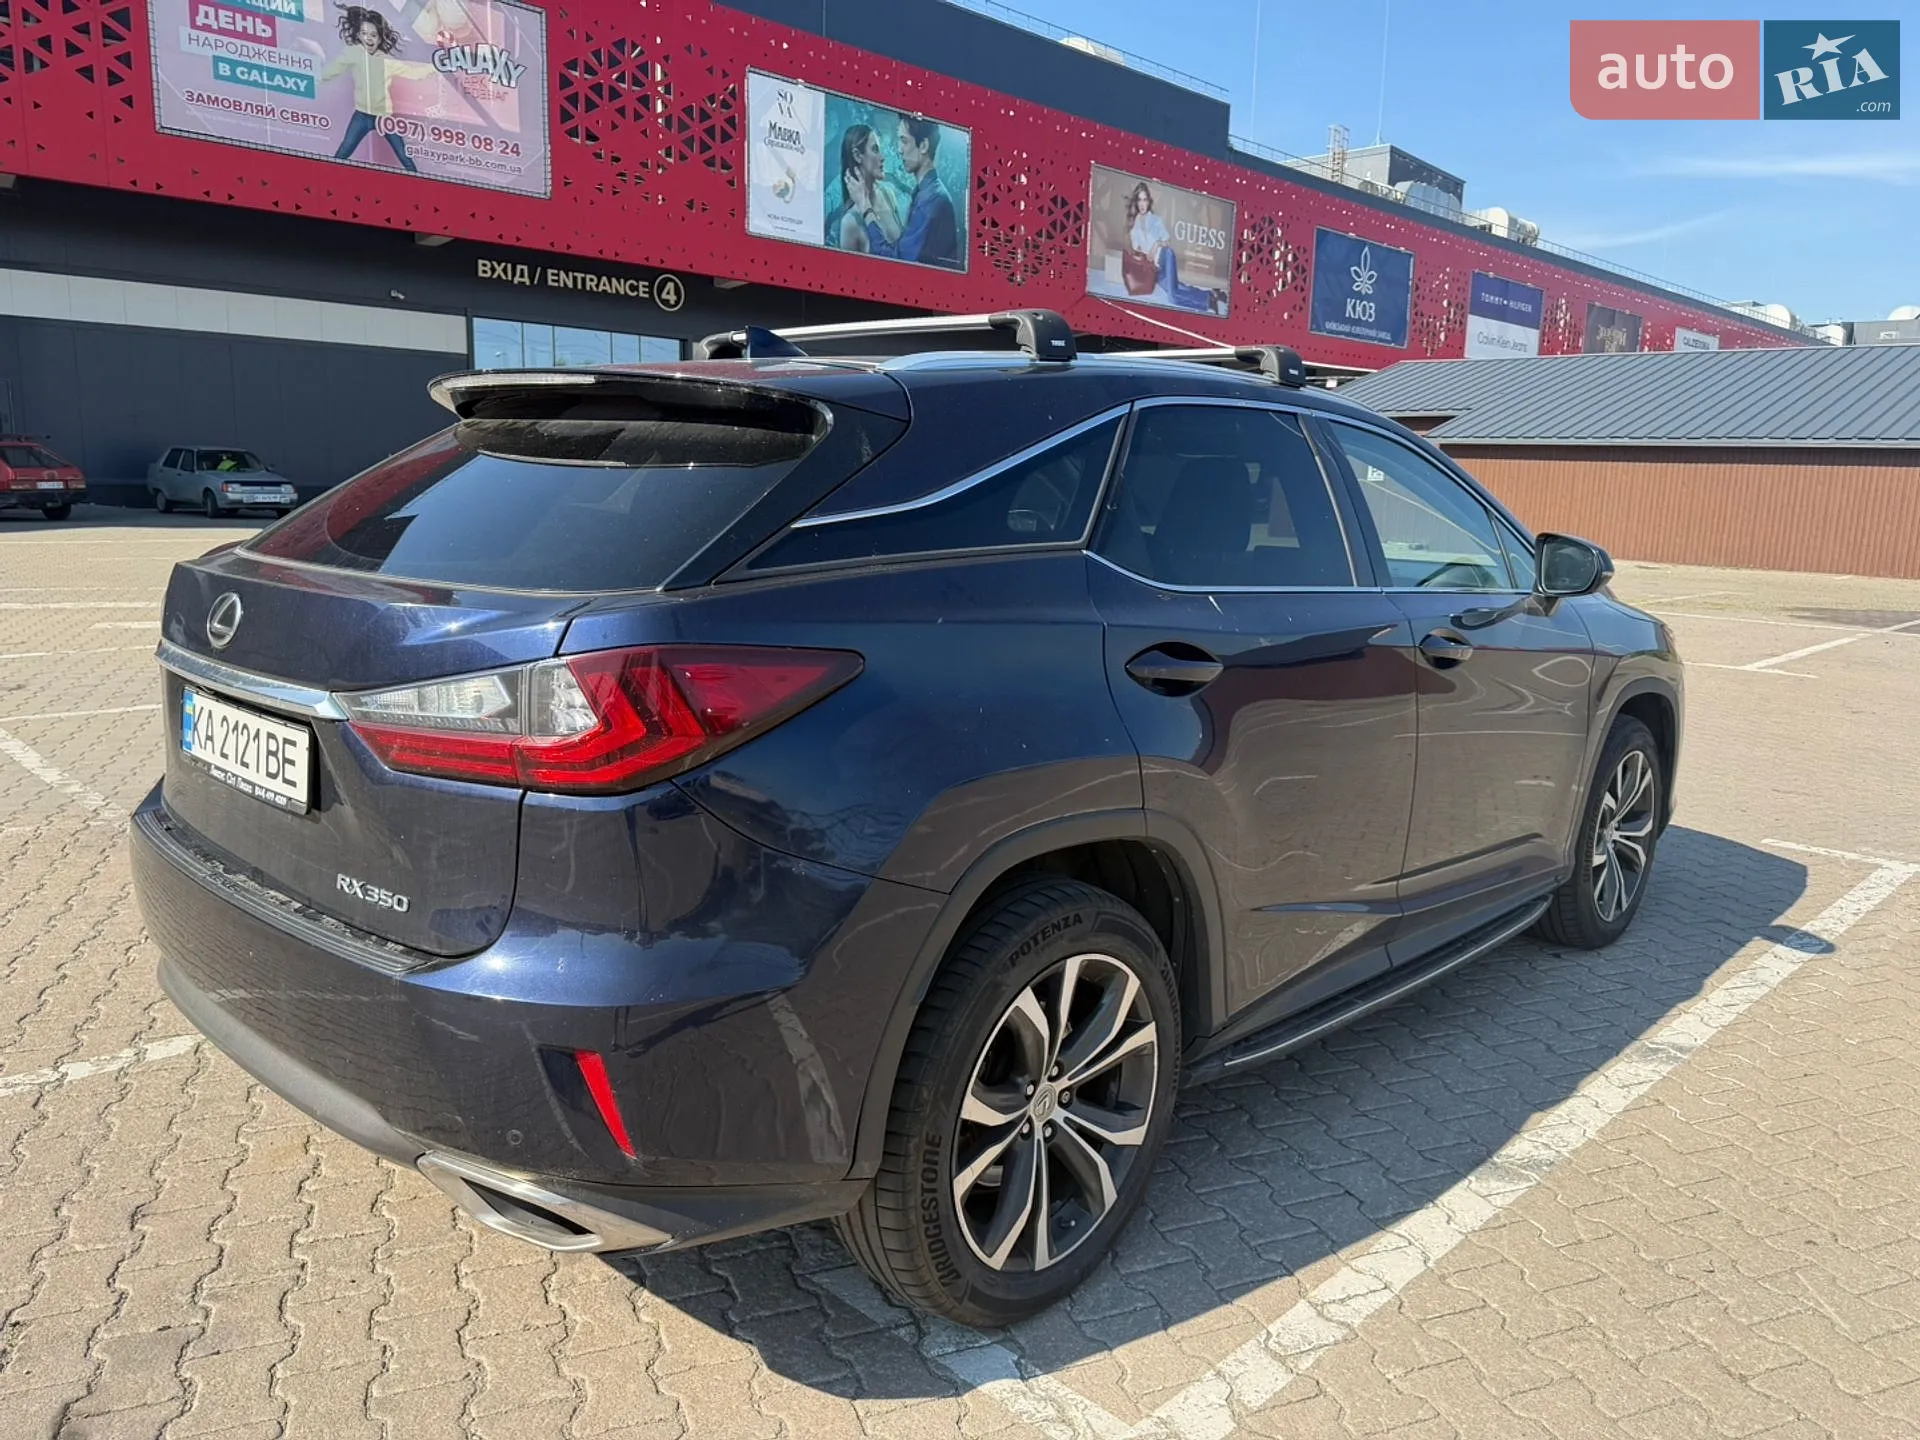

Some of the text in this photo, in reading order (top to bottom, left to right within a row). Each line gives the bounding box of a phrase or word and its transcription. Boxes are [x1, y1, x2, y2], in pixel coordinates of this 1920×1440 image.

[195, 4, 273, 38] ДЕНЬ
[187, 33, 314, 71] НАРОДЖЕННЯ
[432, 43, 528, 89] GALAXY
[235, 66, 309, 92] GALAXY
[184, 90, 276, 117] ЗАМОВЛЯЙ
[279, 109, 330, 128] СВЯТО
[376, 116, 521, 157] (097) 998 08 24
[406, 145, 523, 174] galaxypark-bb.com.ua
[1174, 220, 1225, 250] GUESS
[477, 259, 530, 286] ВХІД
[546, 269, 650, 298] ENTRANCE
[661, 281, 677, 305] 4
[1345, 298, 1375, 322] КЮЗ
[192, 703, 216, 755] KA
[220, 715, 260, 774] 2121
[265, 731, 297, 788] BE
[1008, 912, 1083, 967] POTENZA
[920, 1131, 962, 1287] BRIDGESTONE
